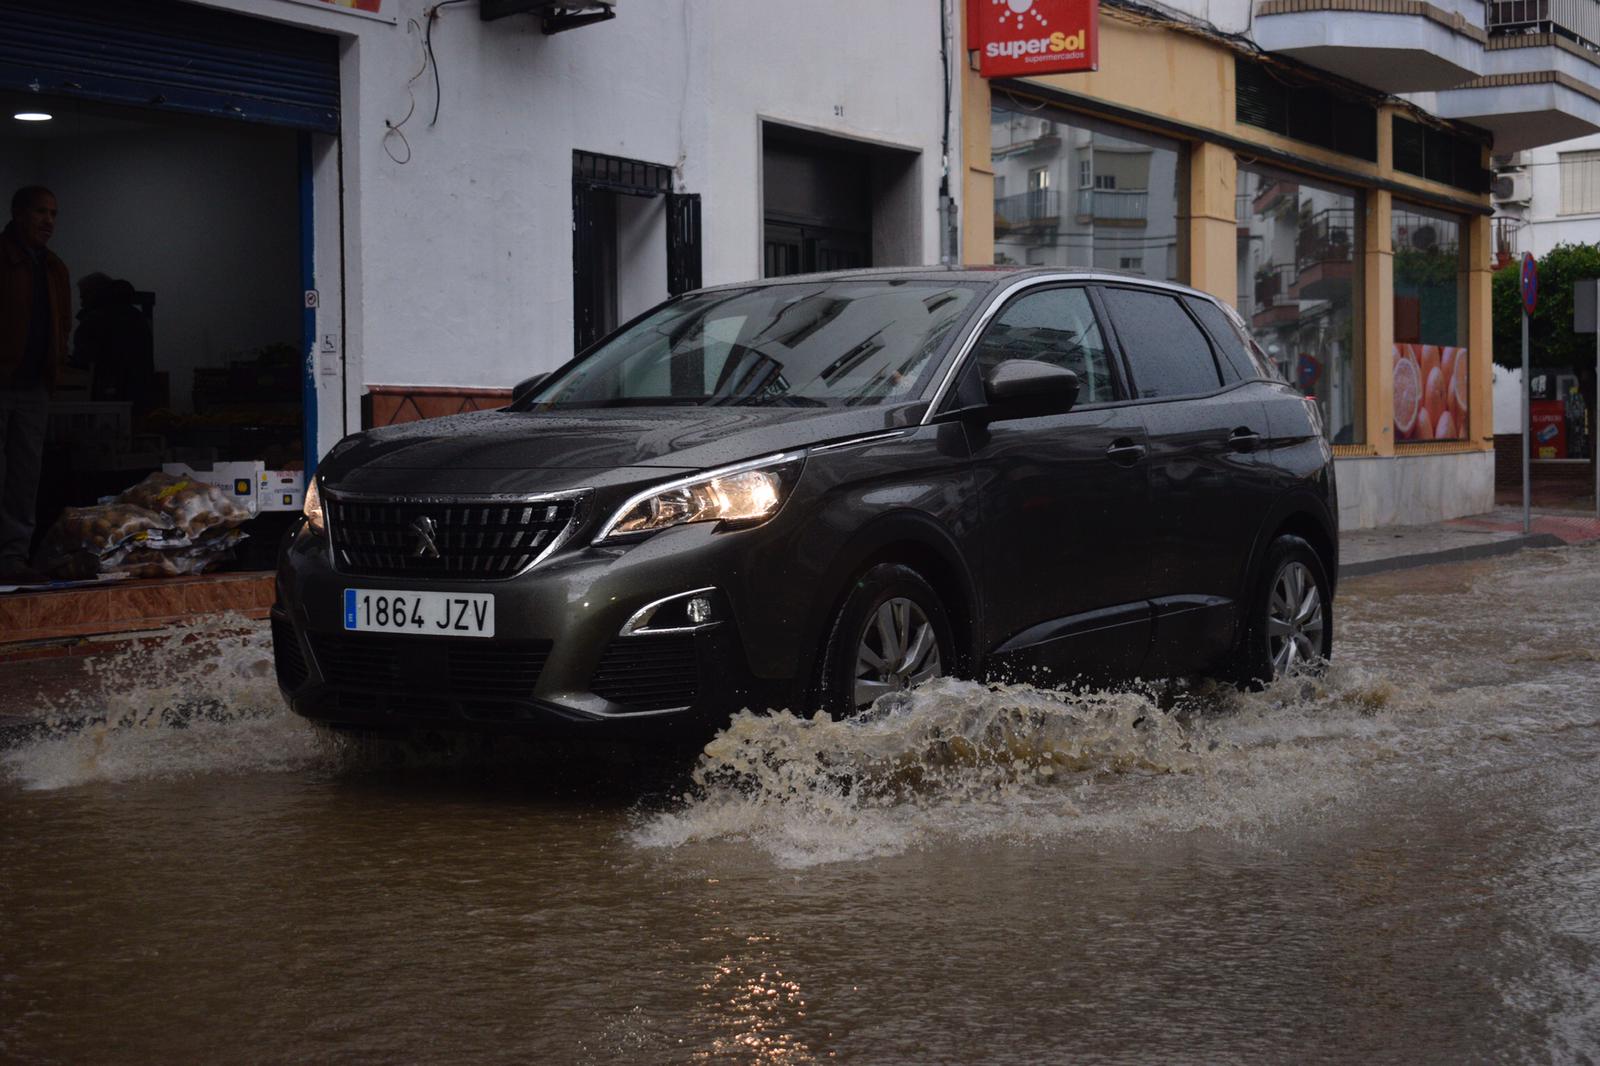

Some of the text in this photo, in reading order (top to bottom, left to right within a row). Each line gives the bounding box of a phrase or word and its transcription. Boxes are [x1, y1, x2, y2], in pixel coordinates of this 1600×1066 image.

[986, 29, 1086, 59] superSol
[1024, 51, 1085, 63] supermercados
[363, 595, 488, 631] 1864 JZV
